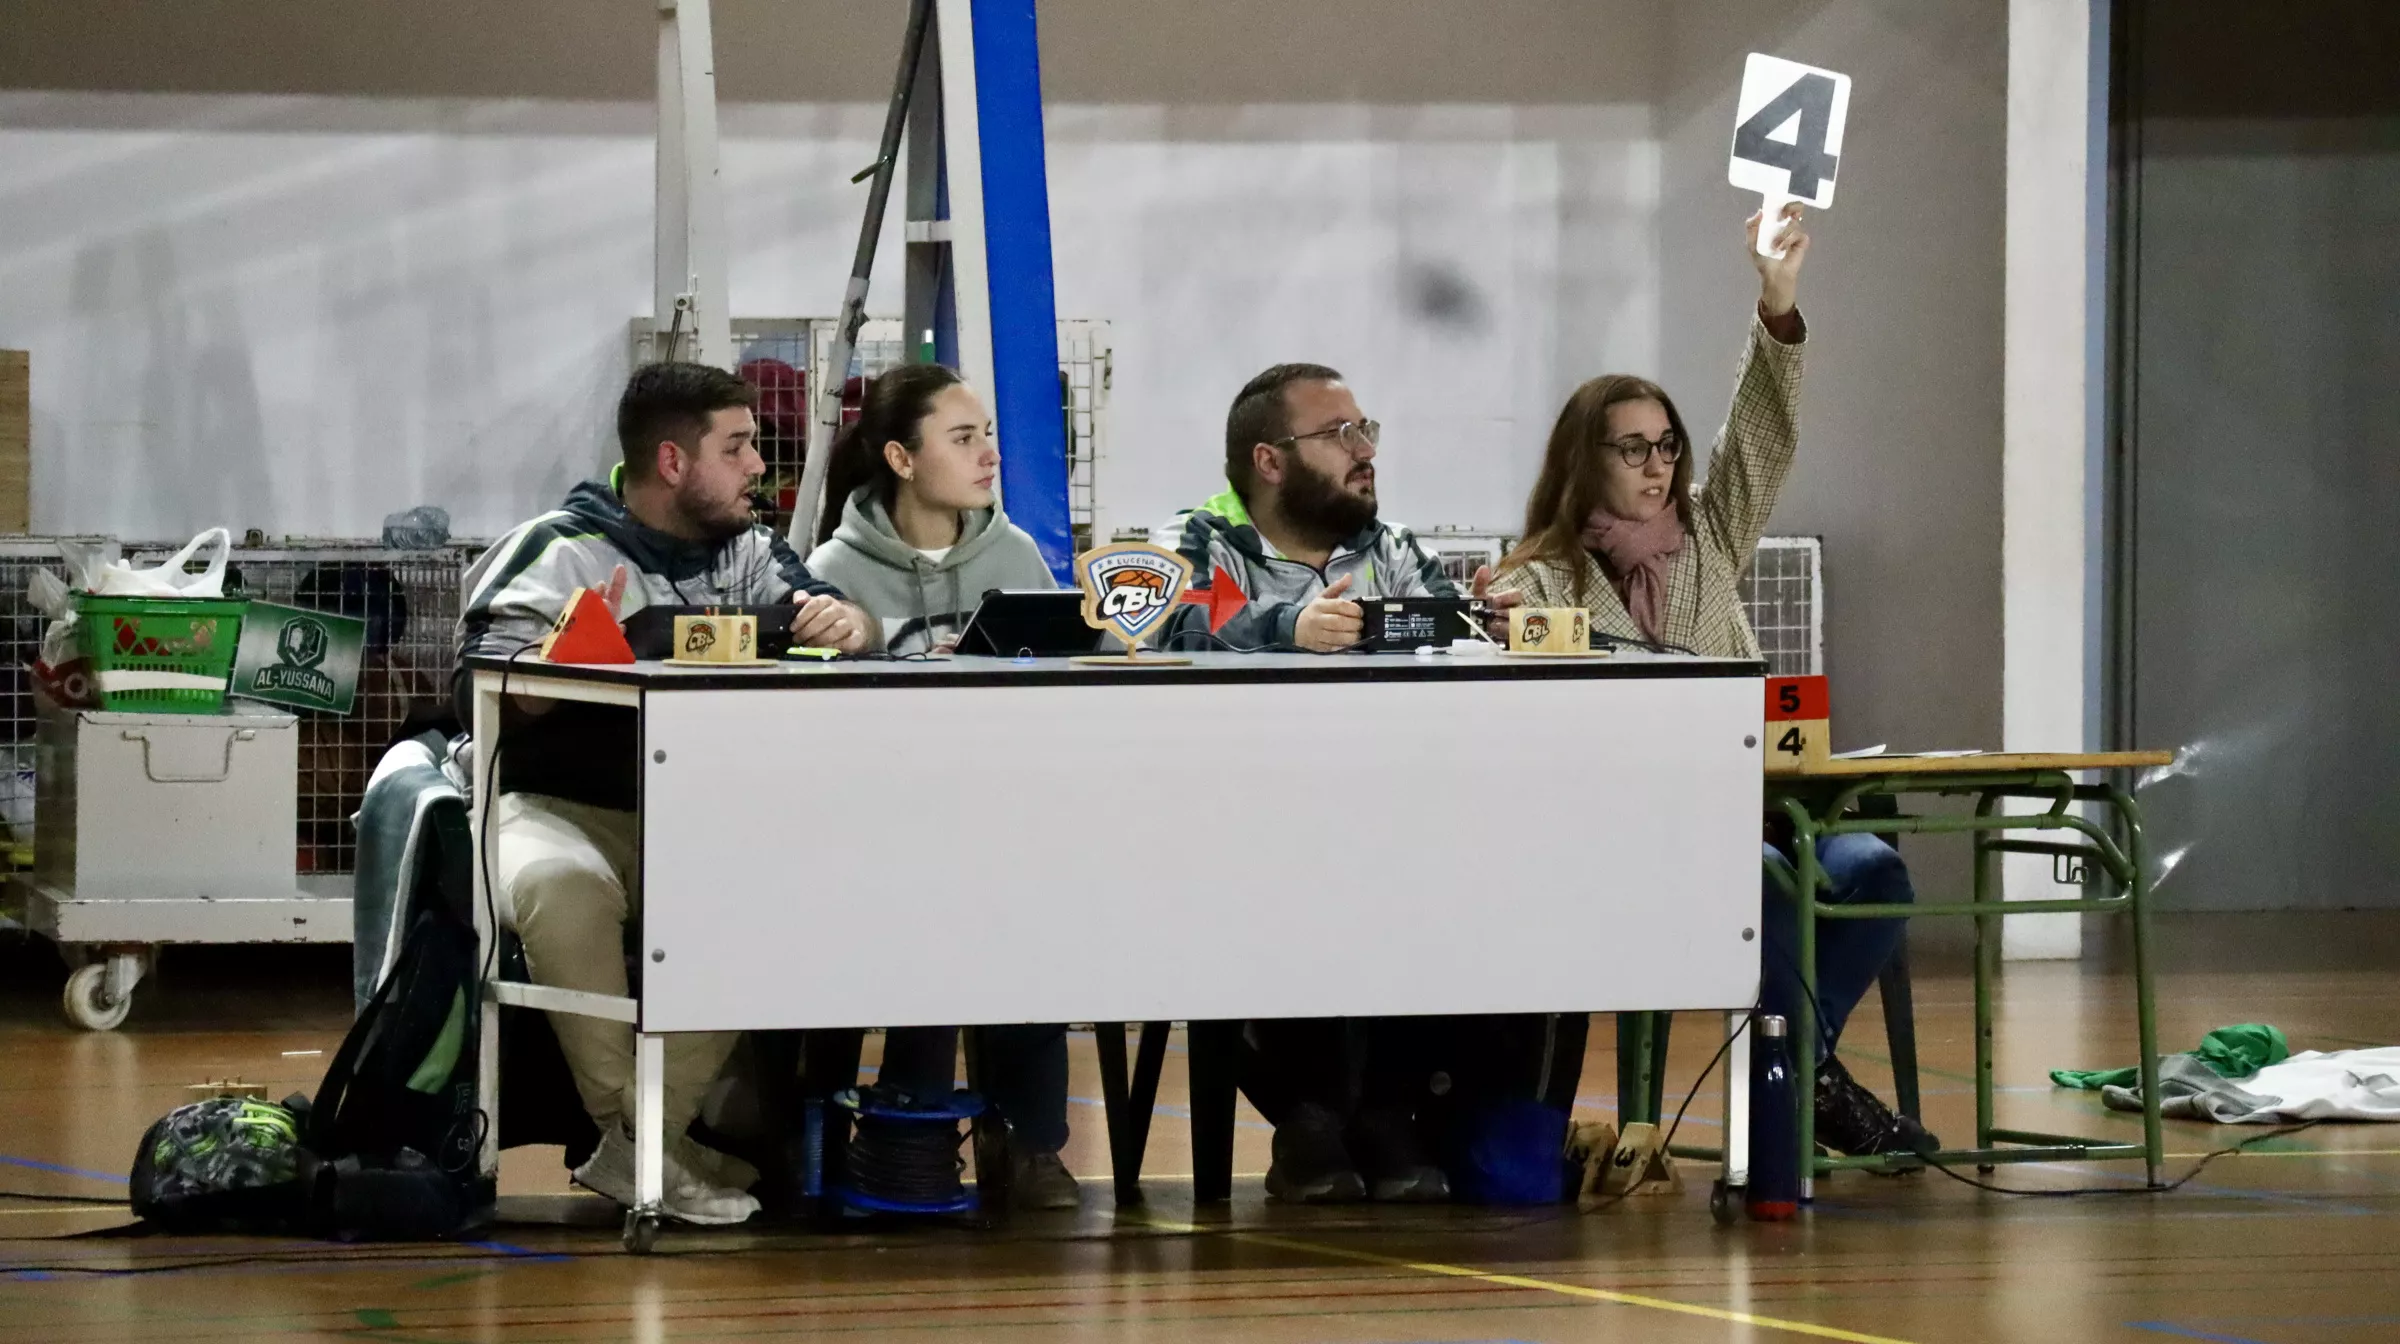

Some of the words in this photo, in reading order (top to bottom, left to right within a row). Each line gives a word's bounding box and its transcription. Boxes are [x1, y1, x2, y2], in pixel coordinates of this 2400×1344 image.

[1733, 72, 1838, 200] 4
[1117, 556, 1155, 566] LUCENA
[1100, 585, 1168, 618] CBL
[256, 669, 333, 698] AL-YUSSANA
[1779, 685, 1800, 713] 5
[1777, 727, 1803, 756] 4
